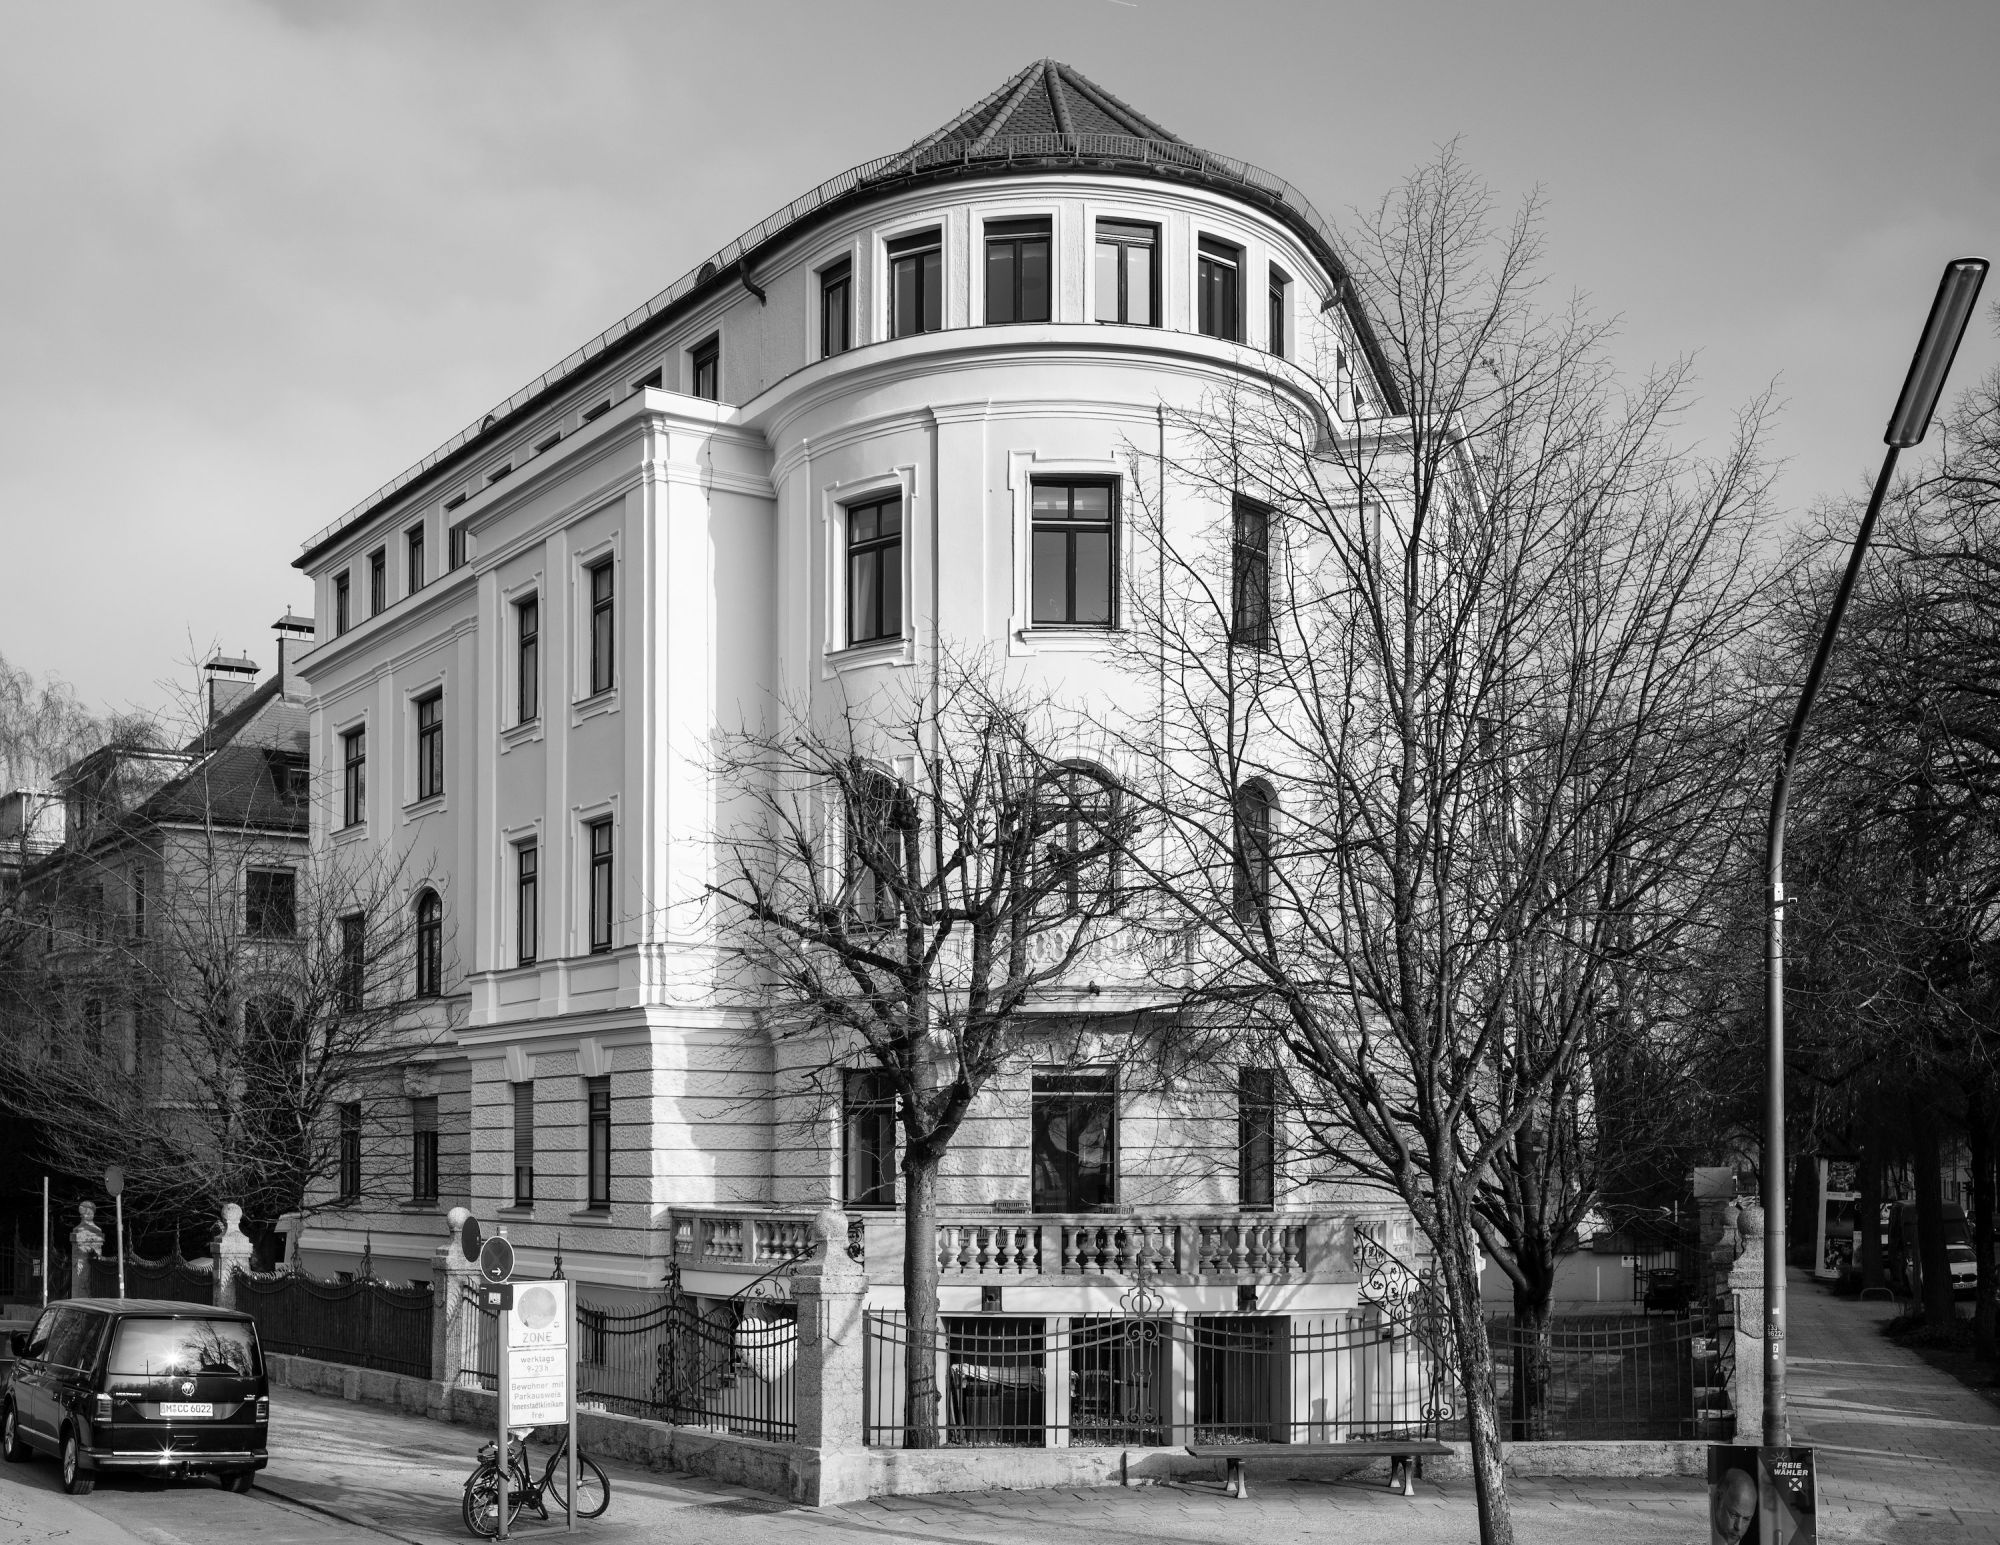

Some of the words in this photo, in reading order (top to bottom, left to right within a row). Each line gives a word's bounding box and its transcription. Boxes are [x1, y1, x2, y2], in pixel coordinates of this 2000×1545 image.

[522, 1332, 552, 1343] ZONE
[521, 1355, 555, 1364] werktags
[511, 1383, 549, 1391] Bewohner
[552, 1380, 564, 1388] mit
[514, 1392, 561, 1400] Parkausweis
[166, 1404, 172, 1413] M
[177, 1404, 189, 1413] CC
[190, 1404, 212, 1413] 6022
[531, 1411, 545, 1419] frei
[1774, 1468, 1809, 1476] WÄHLER
